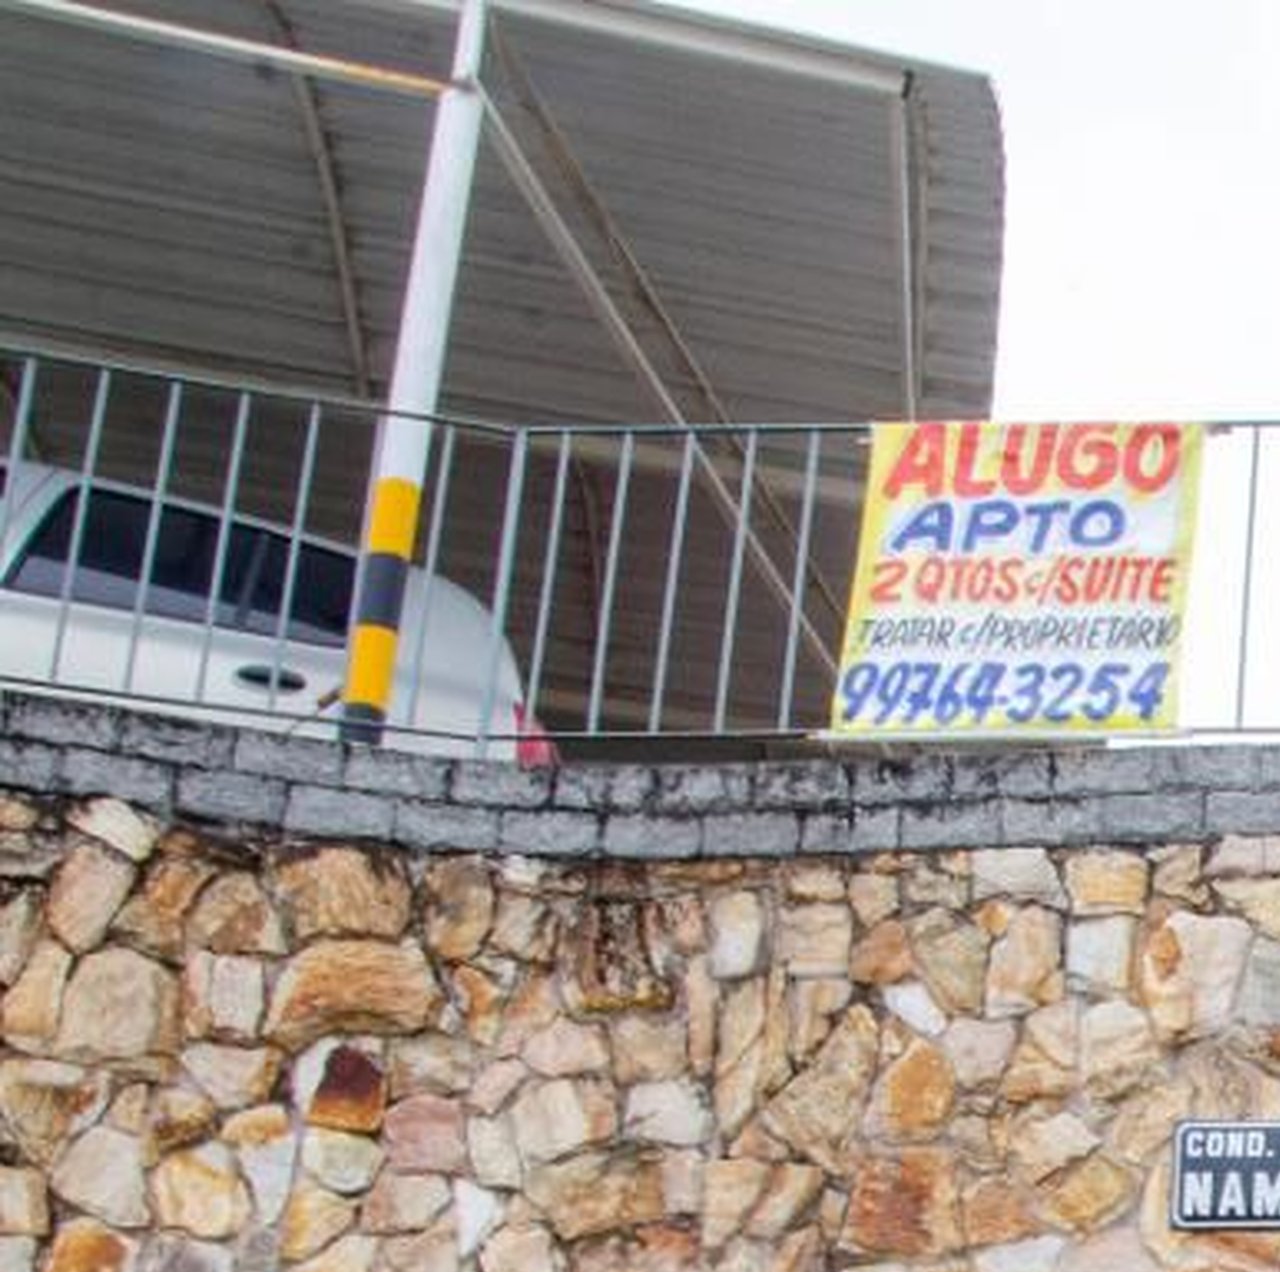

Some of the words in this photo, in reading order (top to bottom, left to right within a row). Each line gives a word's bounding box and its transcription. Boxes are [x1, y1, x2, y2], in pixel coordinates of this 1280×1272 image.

[882, 423, 1184, 498] ALUGO
[892, 501, 1126, 552] APTO
[869, 560, 909, 602] 2
[915, 556, 1024, 604] QTOS
[858, 617, 955, 650] TRATAR
[841, 661, 1172, 725] 99764-3254
[1186, 1131, 1274, 1157] COND.
